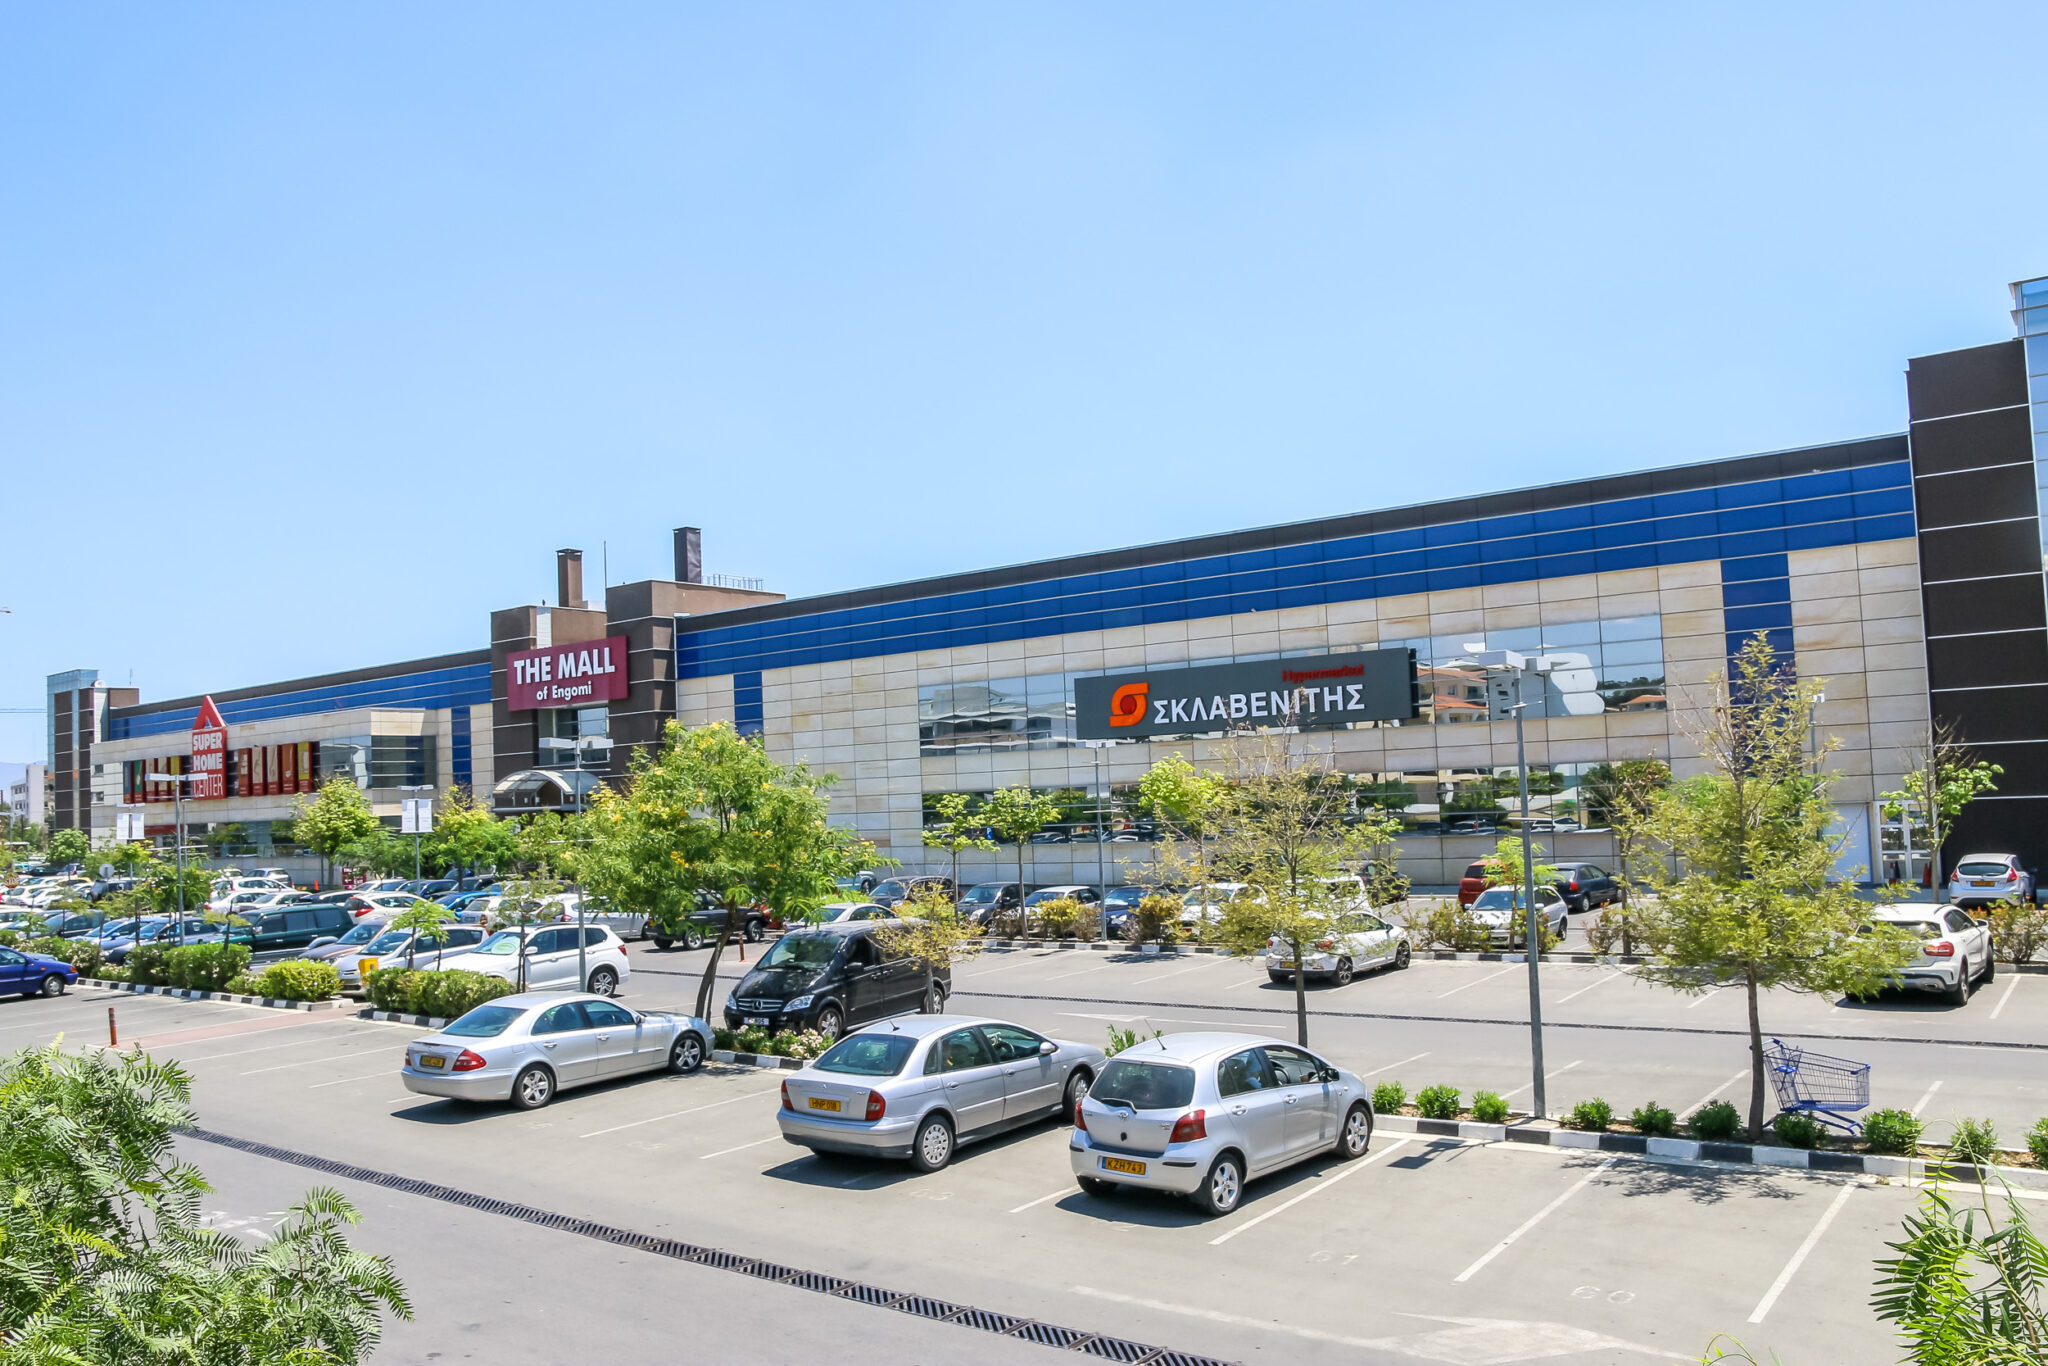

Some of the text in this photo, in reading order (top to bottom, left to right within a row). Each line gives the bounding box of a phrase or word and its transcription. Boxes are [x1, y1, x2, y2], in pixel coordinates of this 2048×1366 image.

[513, 647, 615, 685] THE MALL
[536, 680, 592, 701] of Engomi
[1153, 683, 1366, 725] ΣΚΛΑΒΕΝΙΤΗΣ
[193, 732, 222, 751] SUPER
[193, 753, 223, 771] HOME
[193, 774, 223, 797] CENTER
